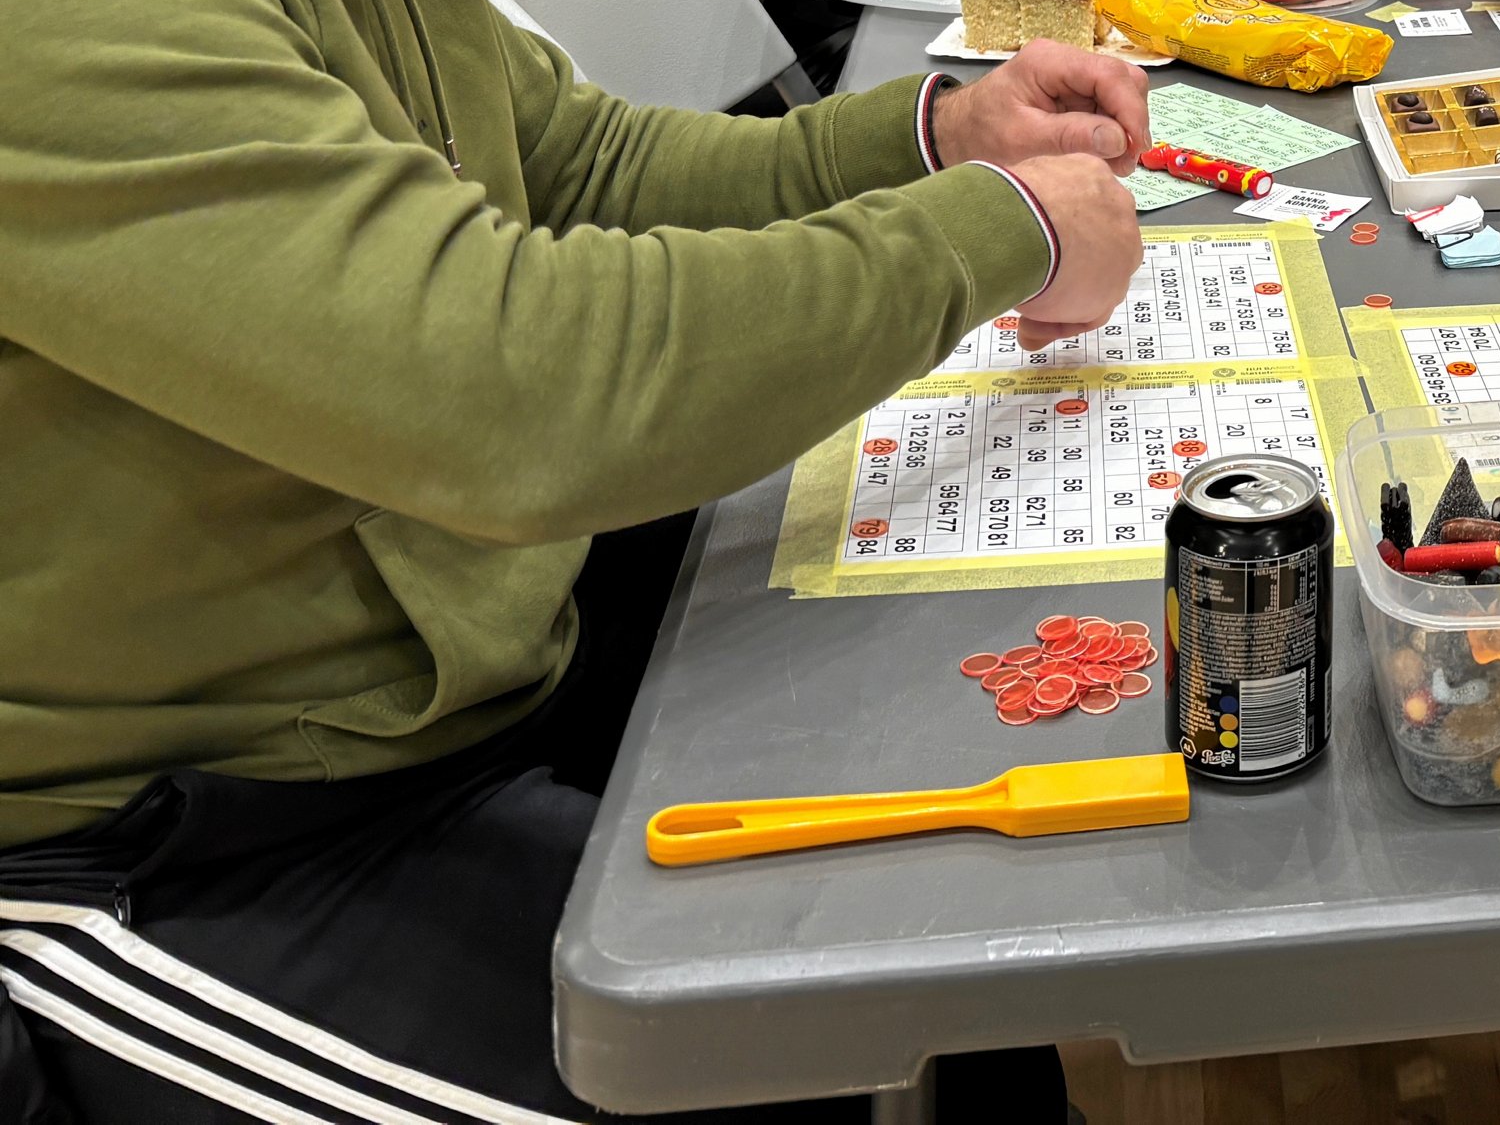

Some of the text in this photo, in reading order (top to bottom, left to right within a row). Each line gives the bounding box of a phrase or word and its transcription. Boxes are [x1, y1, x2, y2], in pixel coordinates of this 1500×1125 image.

[1160, 268, 1182, 322] 13 20 37 40 57
[1229, 266, 1257, 331] 19 21 47 53 62
[1202, 277, 1230, 356] 23 39 41 69 82
[1267, 307, 1284, 318] 50
[1000, 330, 1016, 341] 60
[1134, 301, 1154, 359] 46 59 78 89
[1272, 330, 1289, 341] 75
[1439, 328, 1457, 339] 87
[1470, 327, 1488, 338] 84
[954, 343, 971, 355] 70
[998, 342, 1016, 353] 73
[1062, 338, 1079, 349] 74
[1105, 326, 1123, 360] 63 87
[1275, 343, 1293, 354] 84
[1443, 340, 1462, 352] 73
[1475, 338, 1493, 350] 70
[1030, 353, 1047, 364] 88
[1418, 354, 1436, 365] 60
[1424, 367, 1441, 378] 50
[1427, 379, 1445, 391] 46
[1432, 392, 1451, 405] 35
[1028, 419, 1047, 432] 16
[1063, 418, 1081, 429] 11
[1110, 416, 1129, 428] 18
[1290, 407, 1316, 448] 17 37
[910, 425, 929, 438] 12
[946, 423, 965, 436] 13
[1145, 428, 1163, 441] 21
[1179, 427, 1198, 440] 23
[1226, 424, 1246, 437] 20
[1110, 430, 1129, 443] 25
[908, 439, 928, 452] 26
[1146, 443, 1165, 457] 35
[1181, 440, 1200, 453] 38
[1262, 437, 1281, 450] 34
[1027, 449, 1047, 462] 39
[1063, 448, 1082, 460] 30
[871, 456, 890, 469] 31
[906, 454, 926, 468] 36
[1147, 459, 1167, 471] 41
[867, 472, 888, 486] 47
[1063, 479, 1083, 492] 58
[939, 485, 960, 499] 59
[987, 436, 1013, 547] 22 49 63 70 81
[1026, 497, 1046, 511] 62
[1113, 492, 1133, 506] 60
[938, 501, 958, 515] 64
[1151, 506, 1170, 521] 76
[936, 517, 957, 533] 77
[1026, 513, 1046, 527] 71
[858, 519, 880, 535] 79
[1115, 526, 1136, 541] 82
[1063, 529, 1084, 543] 85
[856, 539, 878, 555] 84
[895, 537, 916, 553] 88
